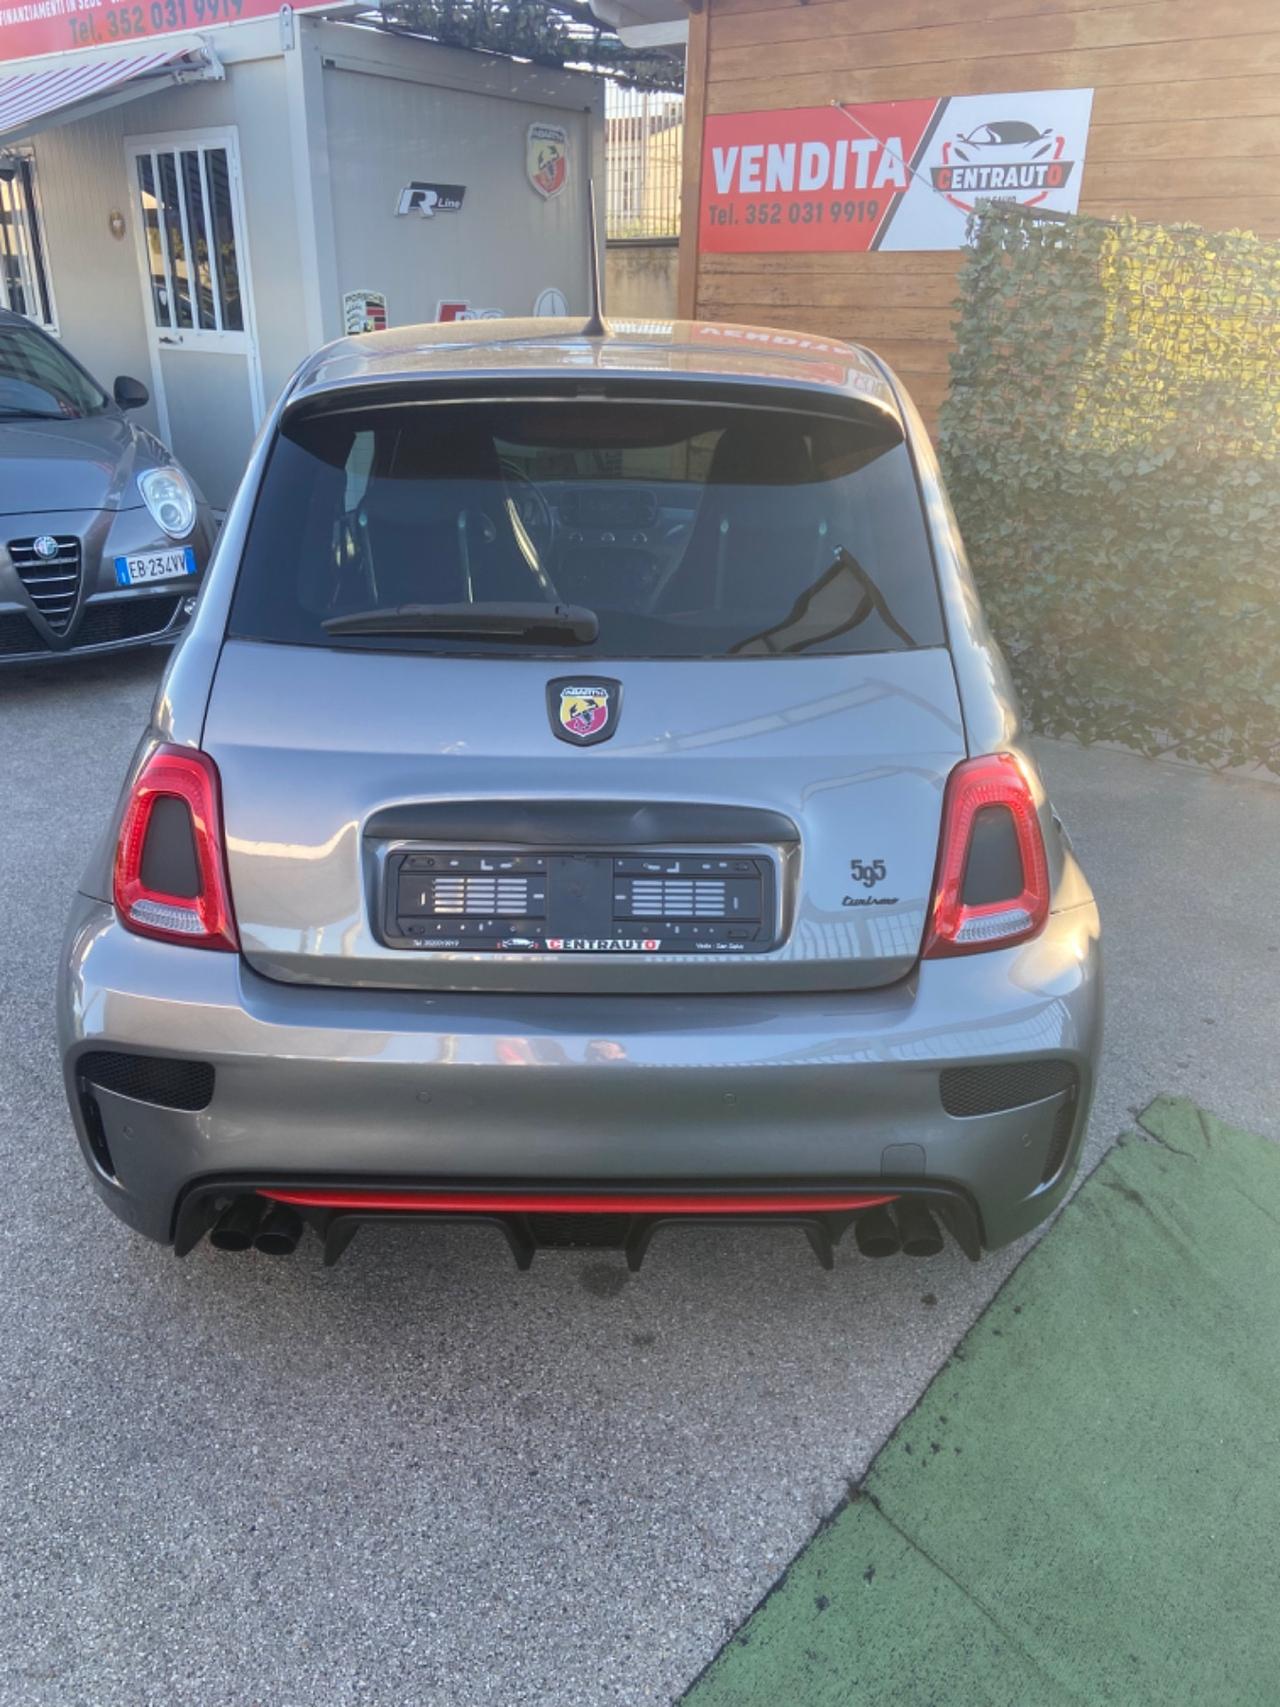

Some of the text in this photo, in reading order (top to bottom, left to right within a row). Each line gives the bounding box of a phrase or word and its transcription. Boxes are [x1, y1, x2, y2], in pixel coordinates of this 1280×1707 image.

[69, 13, 103, 45] Tel.
[106, 6, 146, 37] 352
[150, 0, 187, 30] 031
[711, 136, 907, 194] VENDITA
[937, 163, 1064, 191] CENTRAUTO
[399, 188, 462, 217] R Line
[708, 200, 880, 226] Tel. 352 031 9919
[128, 553, 186, 579] EB 234VV
[850, 859, 887, 888] 595
[548, 939, 658, 951] CENTRAUTO
